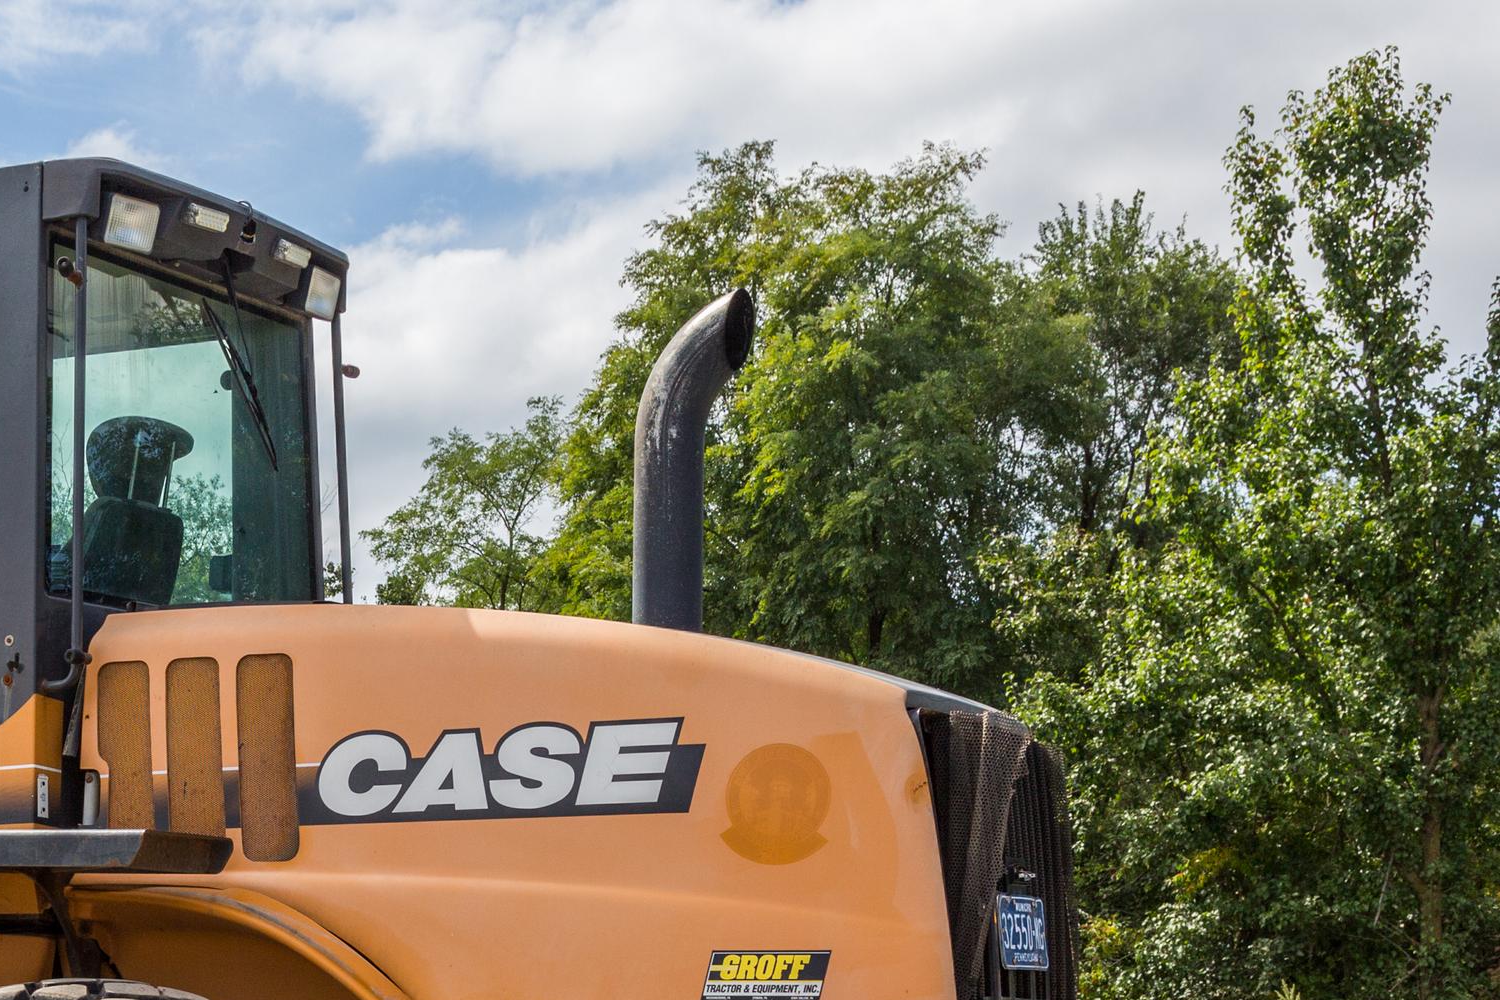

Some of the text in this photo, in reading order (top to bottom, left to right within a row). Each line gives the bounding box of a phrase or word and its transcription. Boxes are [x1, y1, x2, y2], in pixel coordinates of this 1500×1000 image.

[318, 721, 679, 816] CASE
[719, 954, 811, 980] GROFF
[706, 984, 820, 994] TRACTOR & EQUIPMENT, INC.
